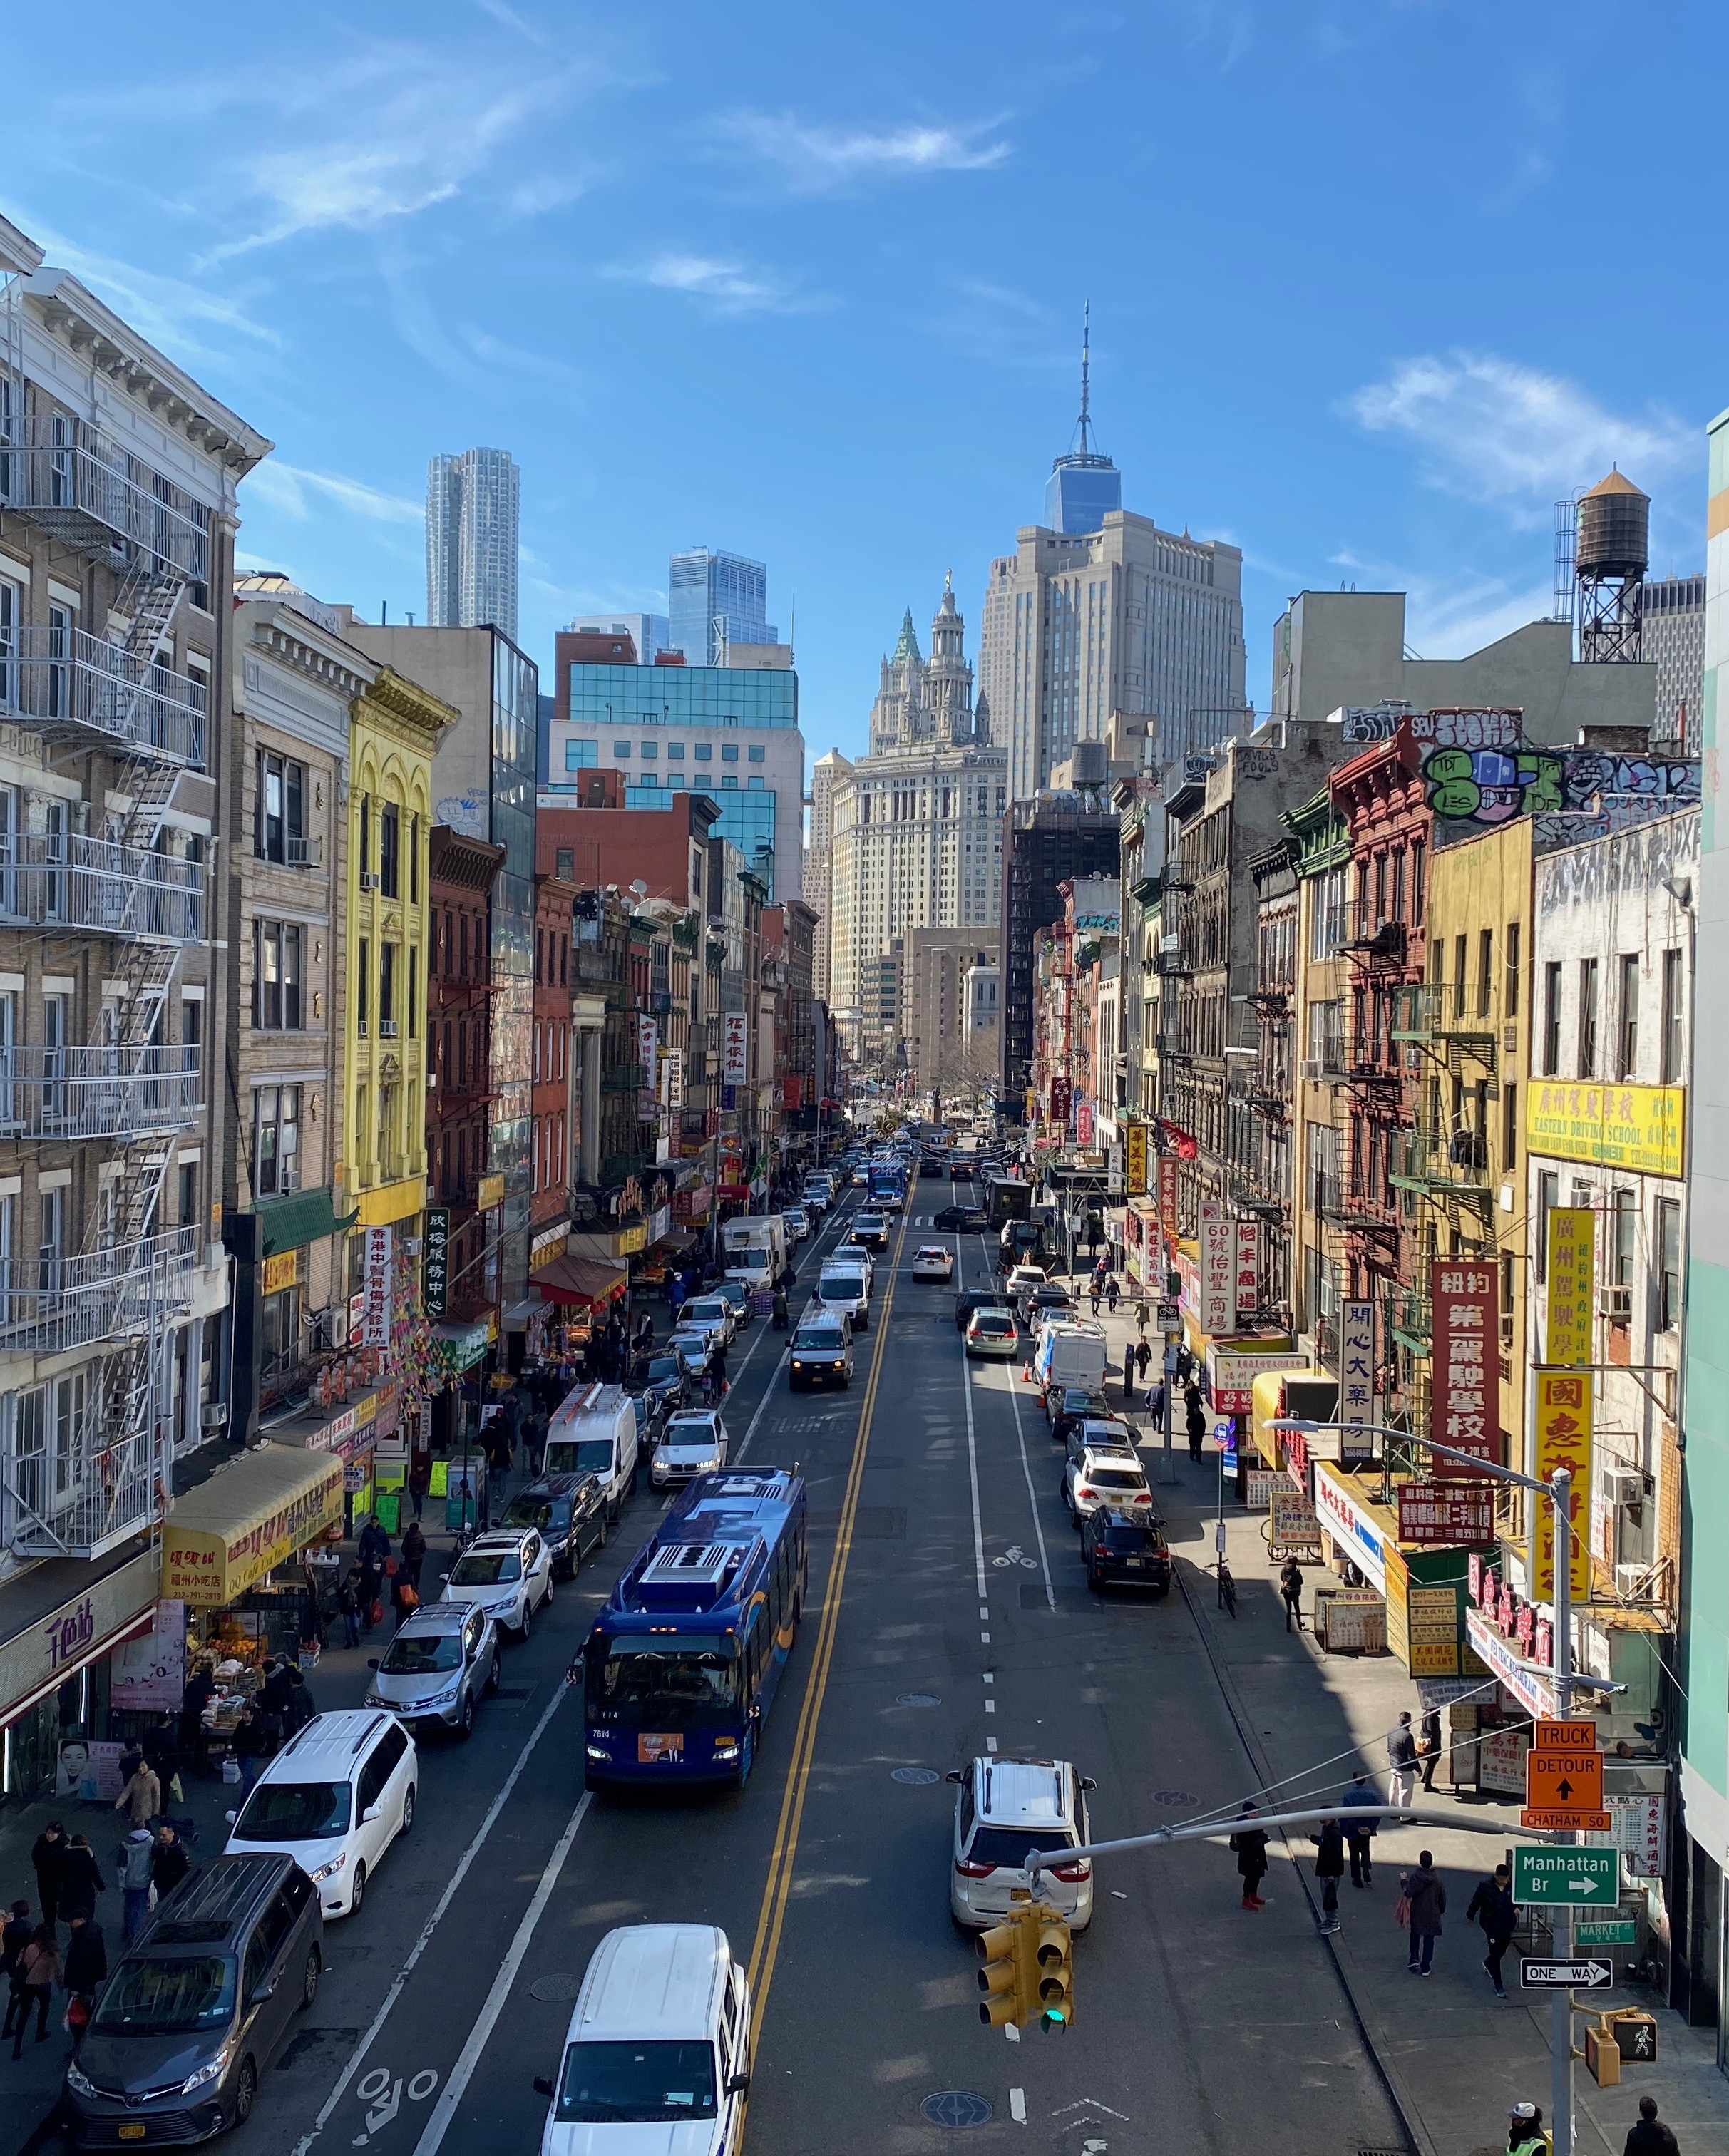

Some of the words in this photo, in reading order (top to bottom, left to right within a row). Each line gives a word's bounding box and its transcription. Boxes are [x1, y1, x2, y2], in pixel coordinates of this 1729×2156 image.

[1243, 760, 1278, 772] FOOLS
[1535, 1116, 1568, 1135] EASTERN
[1571, 1121, 1604, 1141] DRIVING
[1608, 1125, 1642, 1145] SCHOOL
[1129, 1129, 1145, 1191] 華美商場
[1148, 1221, 1160, 1285] 興旺旺商場
[427, 1215, 446, 1311] 欣榕服務中心
[368, 1228, 386, 1338] 香港中醫骨傷科診所
[1440, 1271, 1490, 1294] 紐約
[1343, 1306, 1372, 1439] 開心大藥房
[1446, 1304, 1487, 1441] 第一駕駛學校
[170, 1574, 221, 1588] 福州小吃店
[229, 1574, 242, 1593] QQ
[173, 1591, 222, 1601] 212-791-2819
[592, 1730, 610, 1738] 7614
[1541, 1727, 1591, 1744] TRUCK
[1537, 1759, 1595, 1773] DETOUR
[1527, 1814, 1581, 1827] CHATHAM
[1523, 1856, 1609, 1872] Manhattan
[1532, 1877, 1549, 1892] Br
[1580, 1924, 1621, 1936] MARKET
[1530, 1968, 1556, 1979] ONE
[1571, 1968, 1600, 1979] WAY
